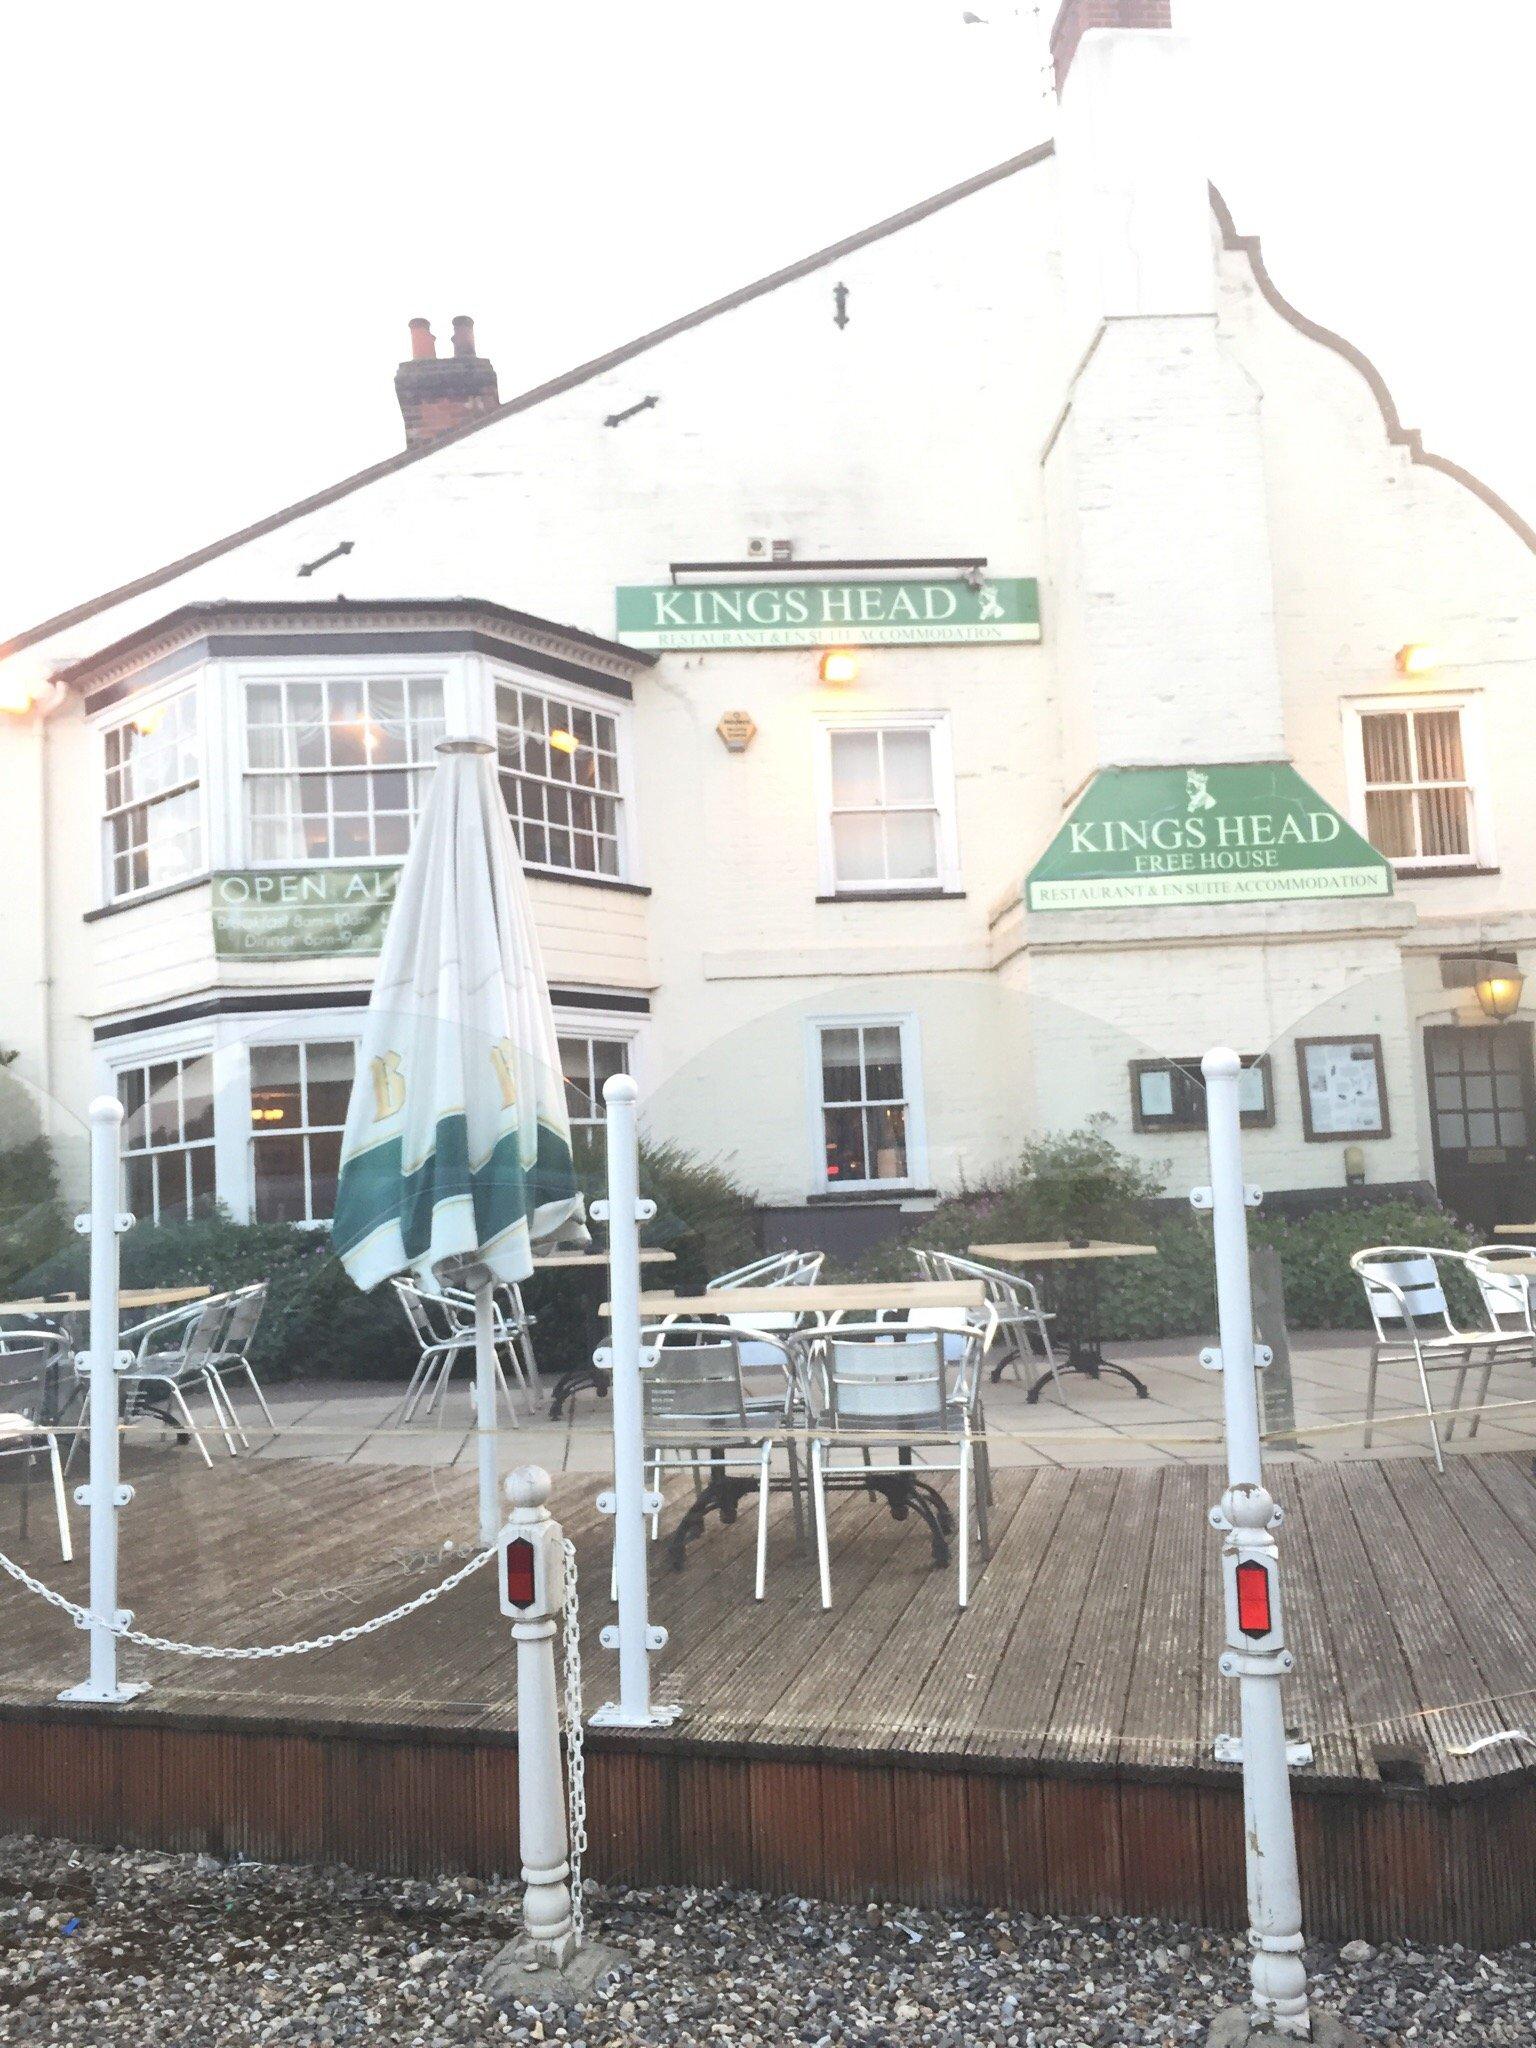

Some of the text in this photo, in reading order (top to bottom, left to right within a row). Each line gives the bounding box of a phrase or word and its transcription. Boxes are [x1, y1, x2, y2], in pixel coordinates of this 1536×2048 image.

[653, 586, 958, 626] KINGS HEAD
[658, 632, 767, 646] RESTAURANT
[861, 627, 1002, 642] ACCOMMODATION
[1069, 811, 1341, 853] KINGS HEAD
[1135, 850, 1279, 873] FREE HOUSE
[220, 872, 390, 903] OPEN AL
[1040, 884, 1143, 901] RESTAURANT
[1163, 884, 1183, 896] EN
[1187, 881, 1230, 895] SUITE
[1235, 875, 1378, 893] ACCOMMODATION
